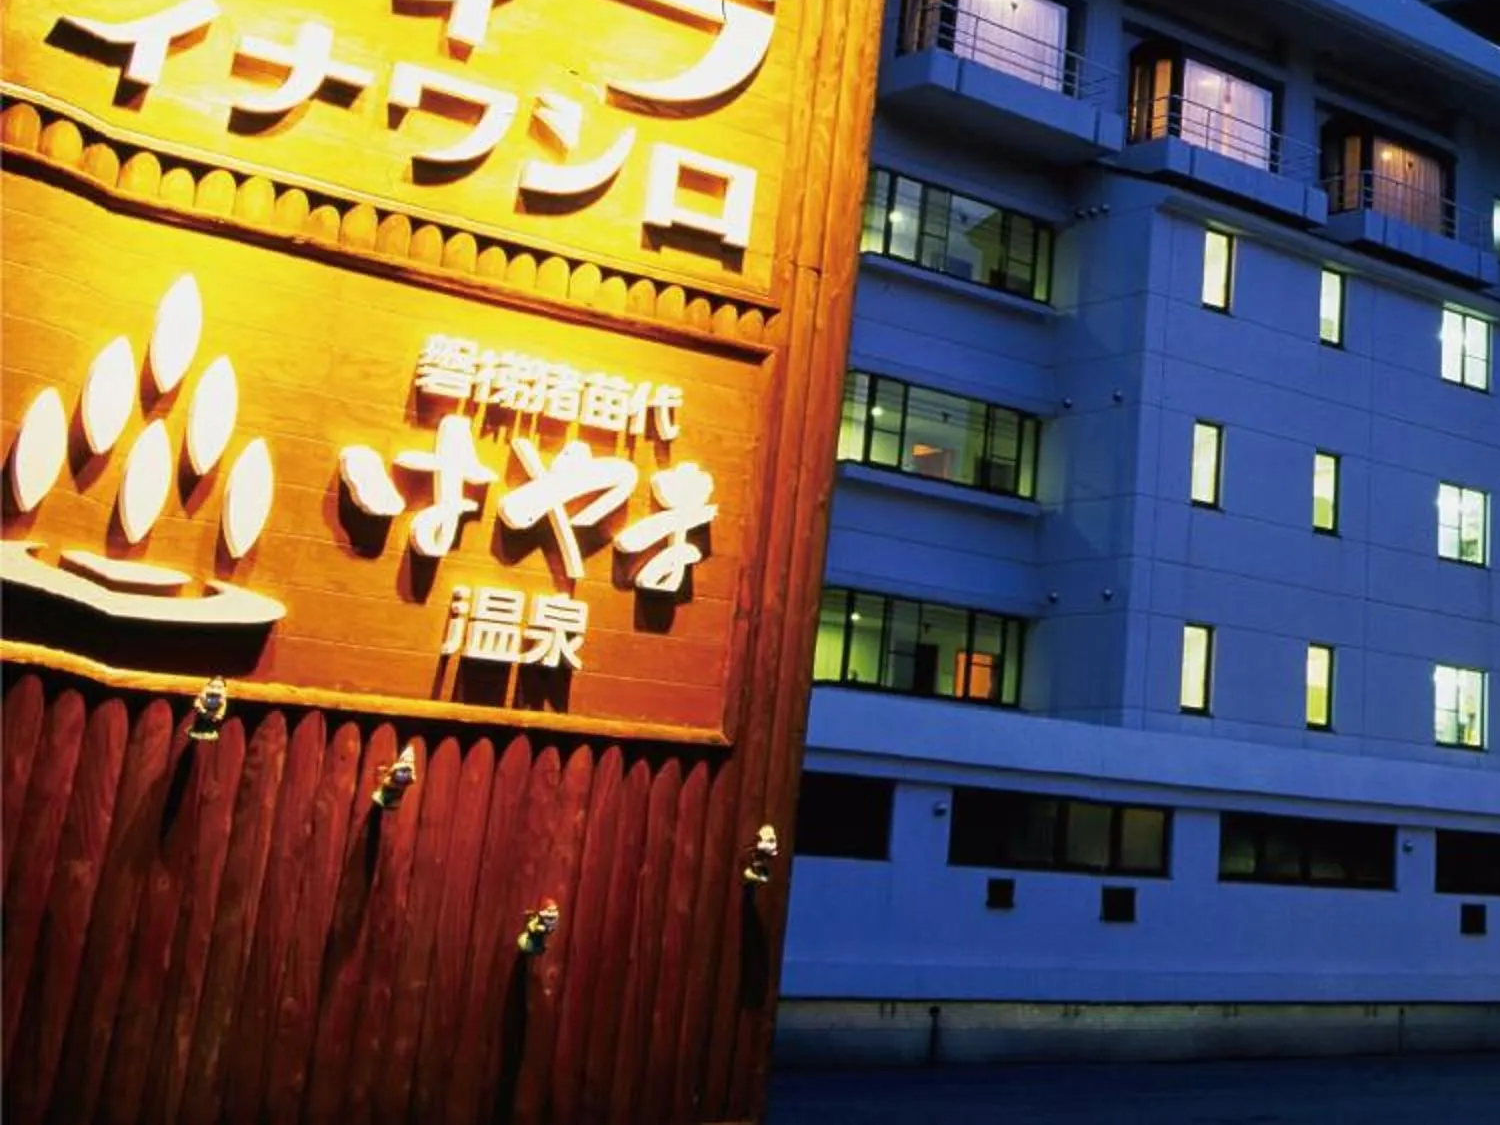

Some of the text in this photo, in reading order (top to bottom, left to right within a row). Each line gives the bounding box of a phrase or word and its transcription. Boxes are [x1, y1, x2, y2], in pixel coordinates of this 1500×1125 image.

[338, 413, 719, 593] はやま
[441, 584, 591, 671] 温泉
